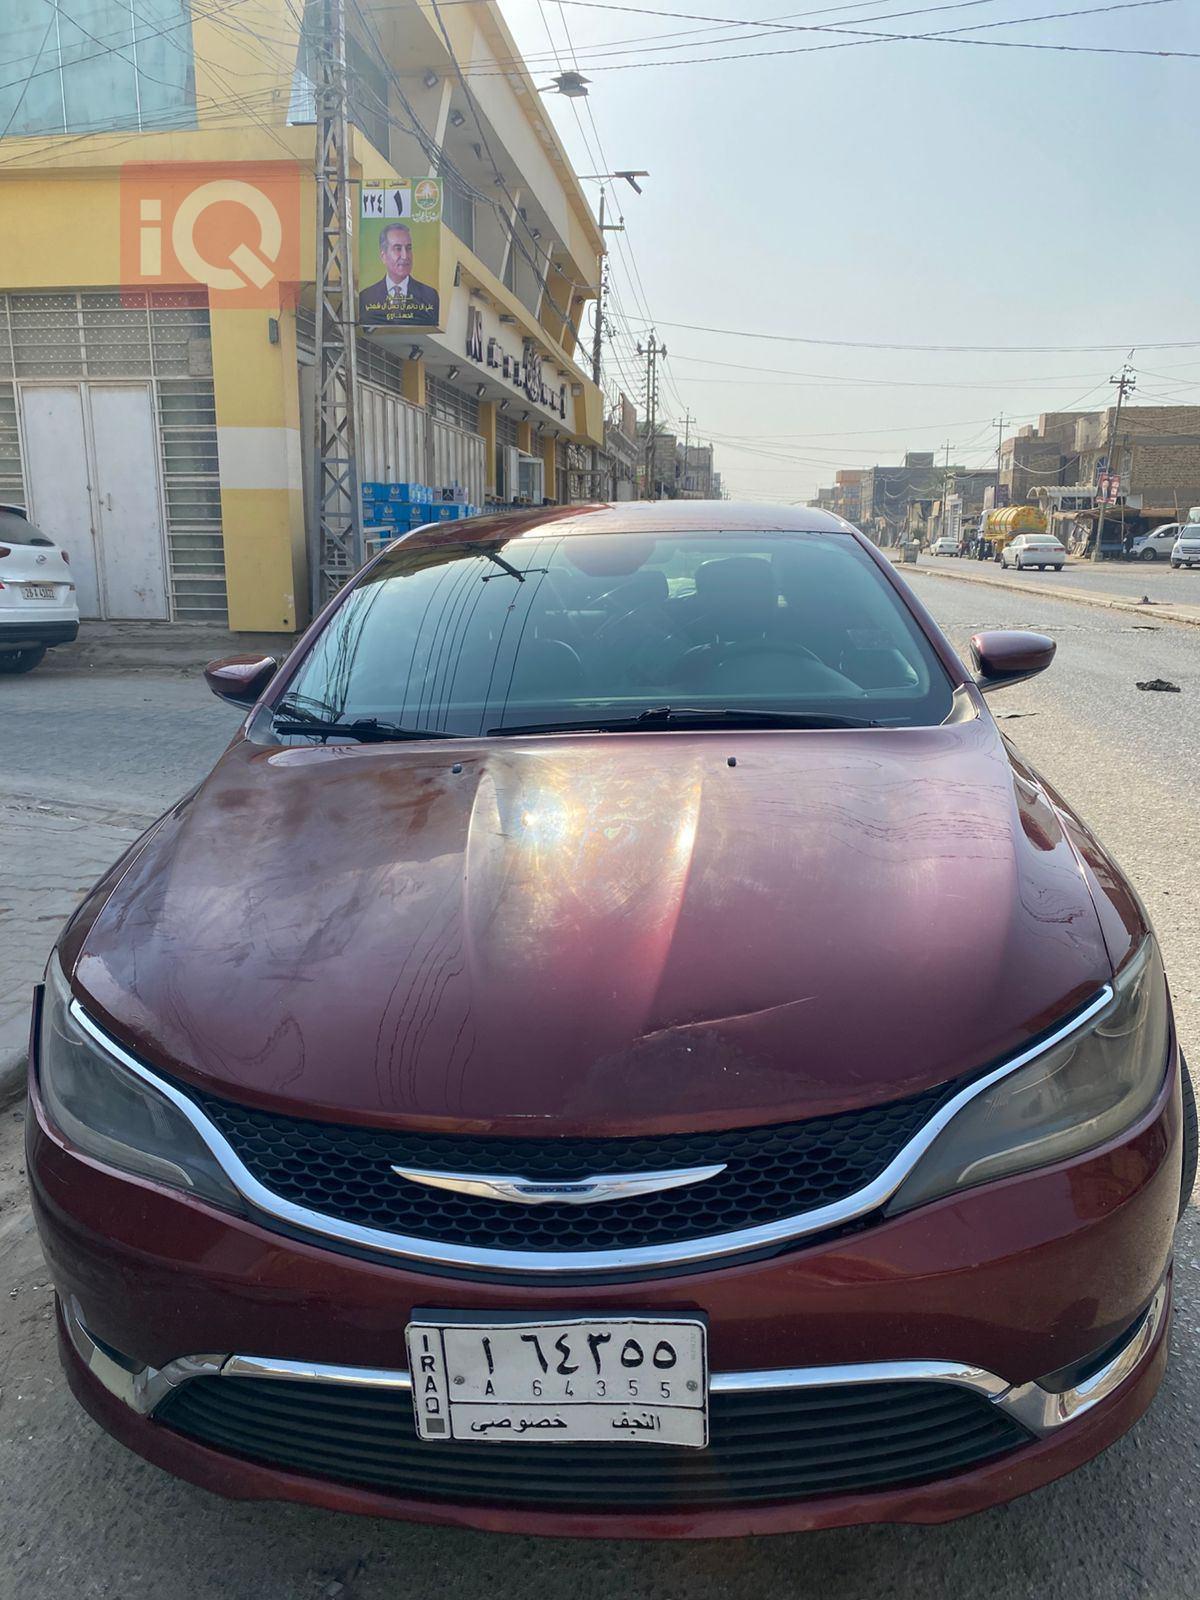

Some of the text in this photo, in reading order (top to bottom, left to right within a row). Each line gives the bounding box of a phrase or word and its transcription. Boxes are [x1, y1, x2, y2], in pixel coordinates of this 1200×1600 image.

[485, 1380, 495, 1396] A
[471, 1410, 661, 1435] النجف خصوصي
